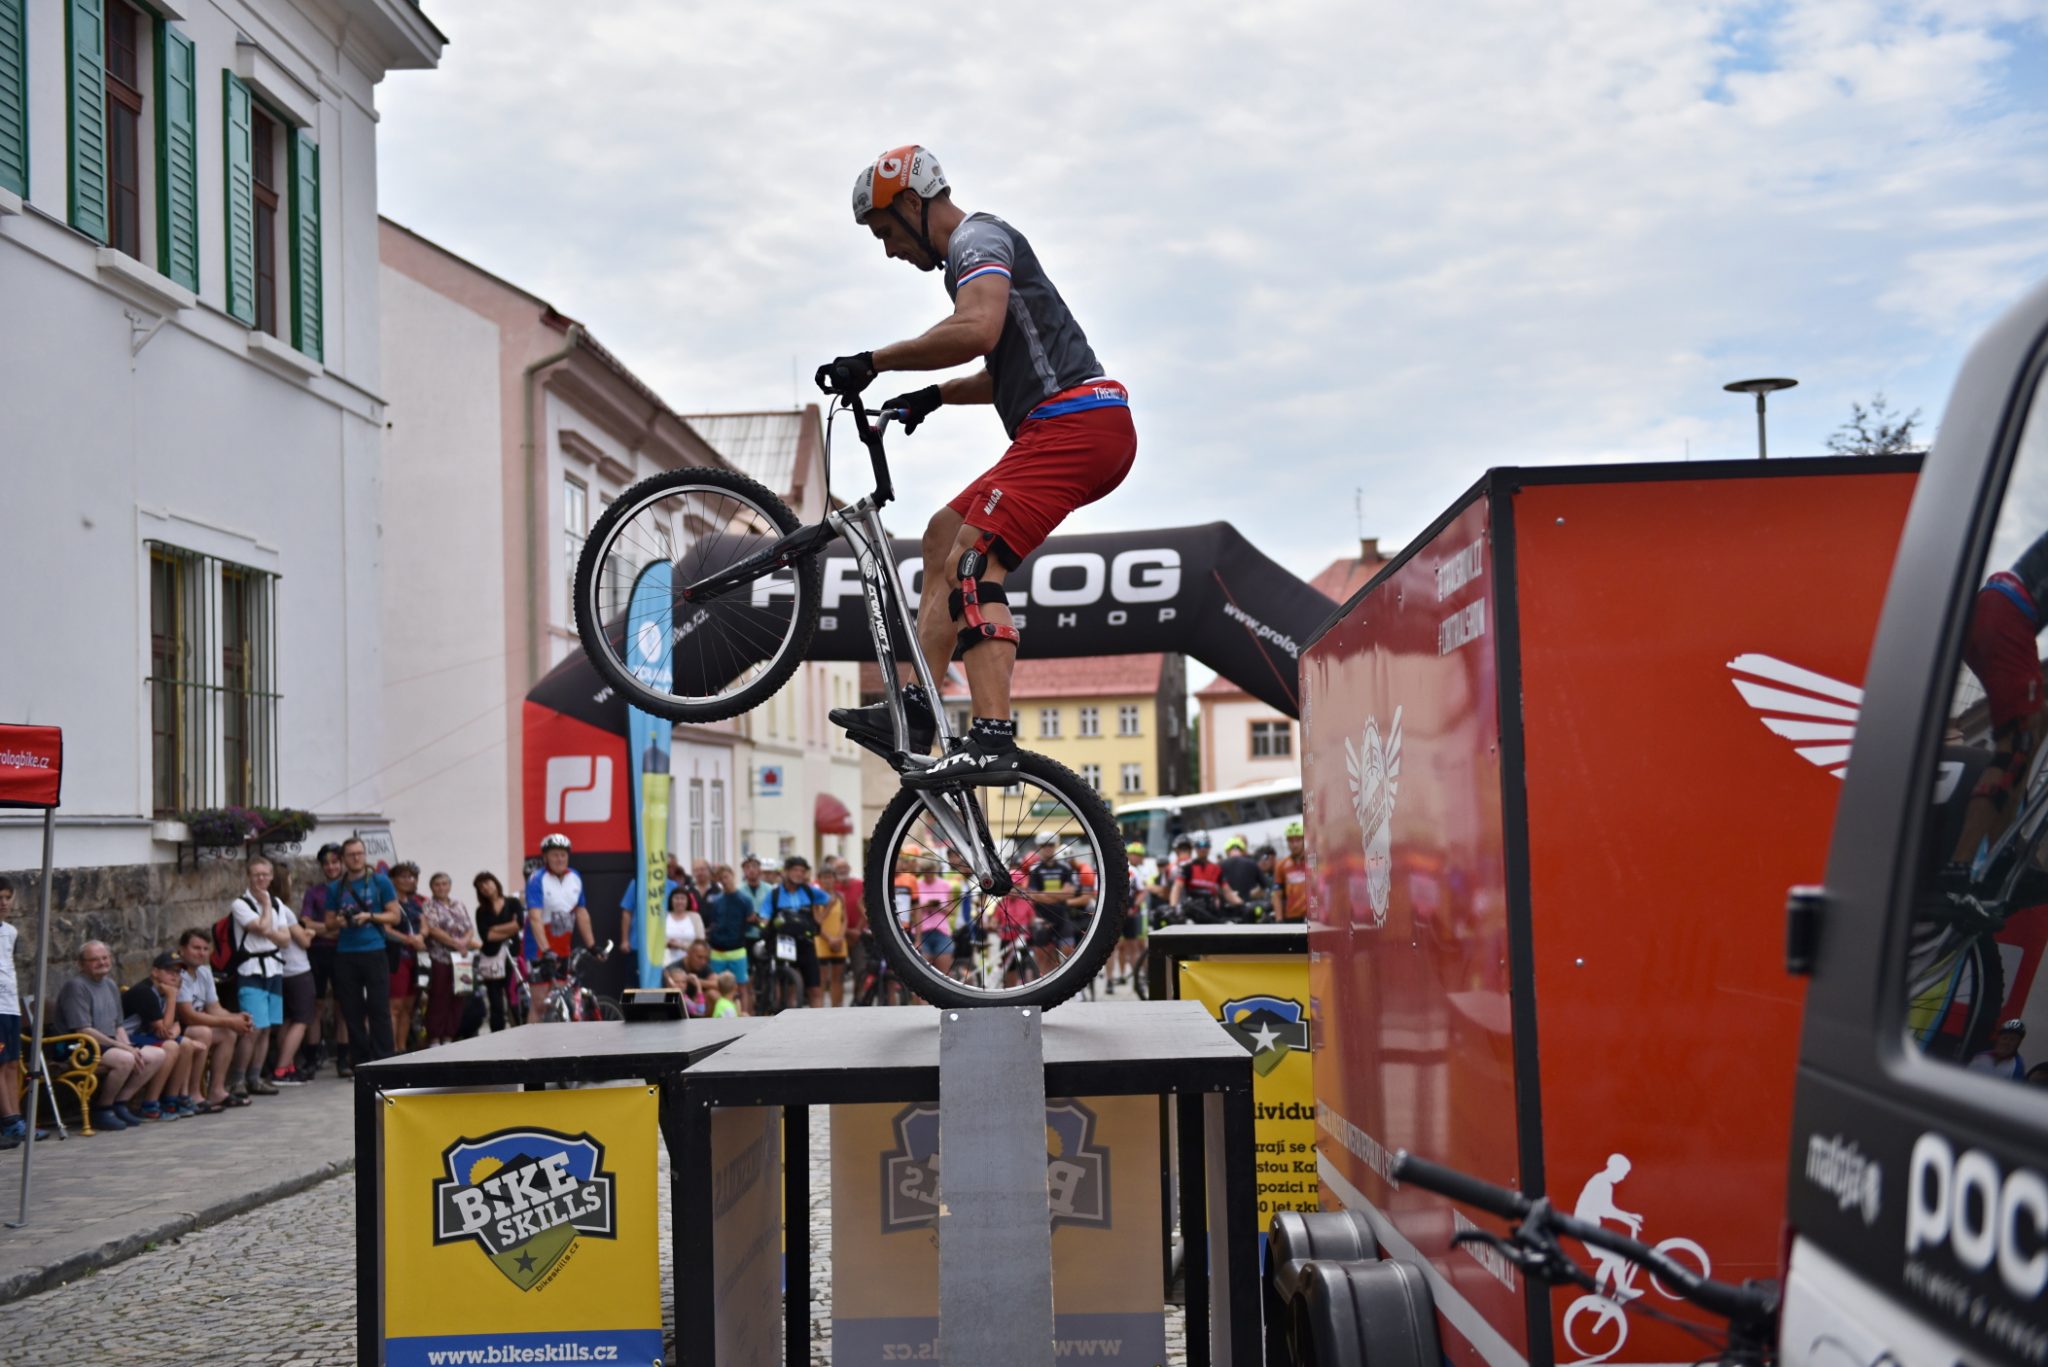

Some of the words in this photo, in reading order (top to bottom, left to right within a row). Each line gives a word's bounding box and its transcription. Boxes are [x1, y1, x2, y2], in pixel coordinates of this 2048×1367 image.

[1290, 1143, 1306, 1153] se
[452, 1151, 579, 1232] BIKE
[497, 1185, 601, 1246] SKILLS
[535, 1242, 580, 1292] bikeskills.cz
[428, 1343, 618, 1366] www.bikeskills.cz
